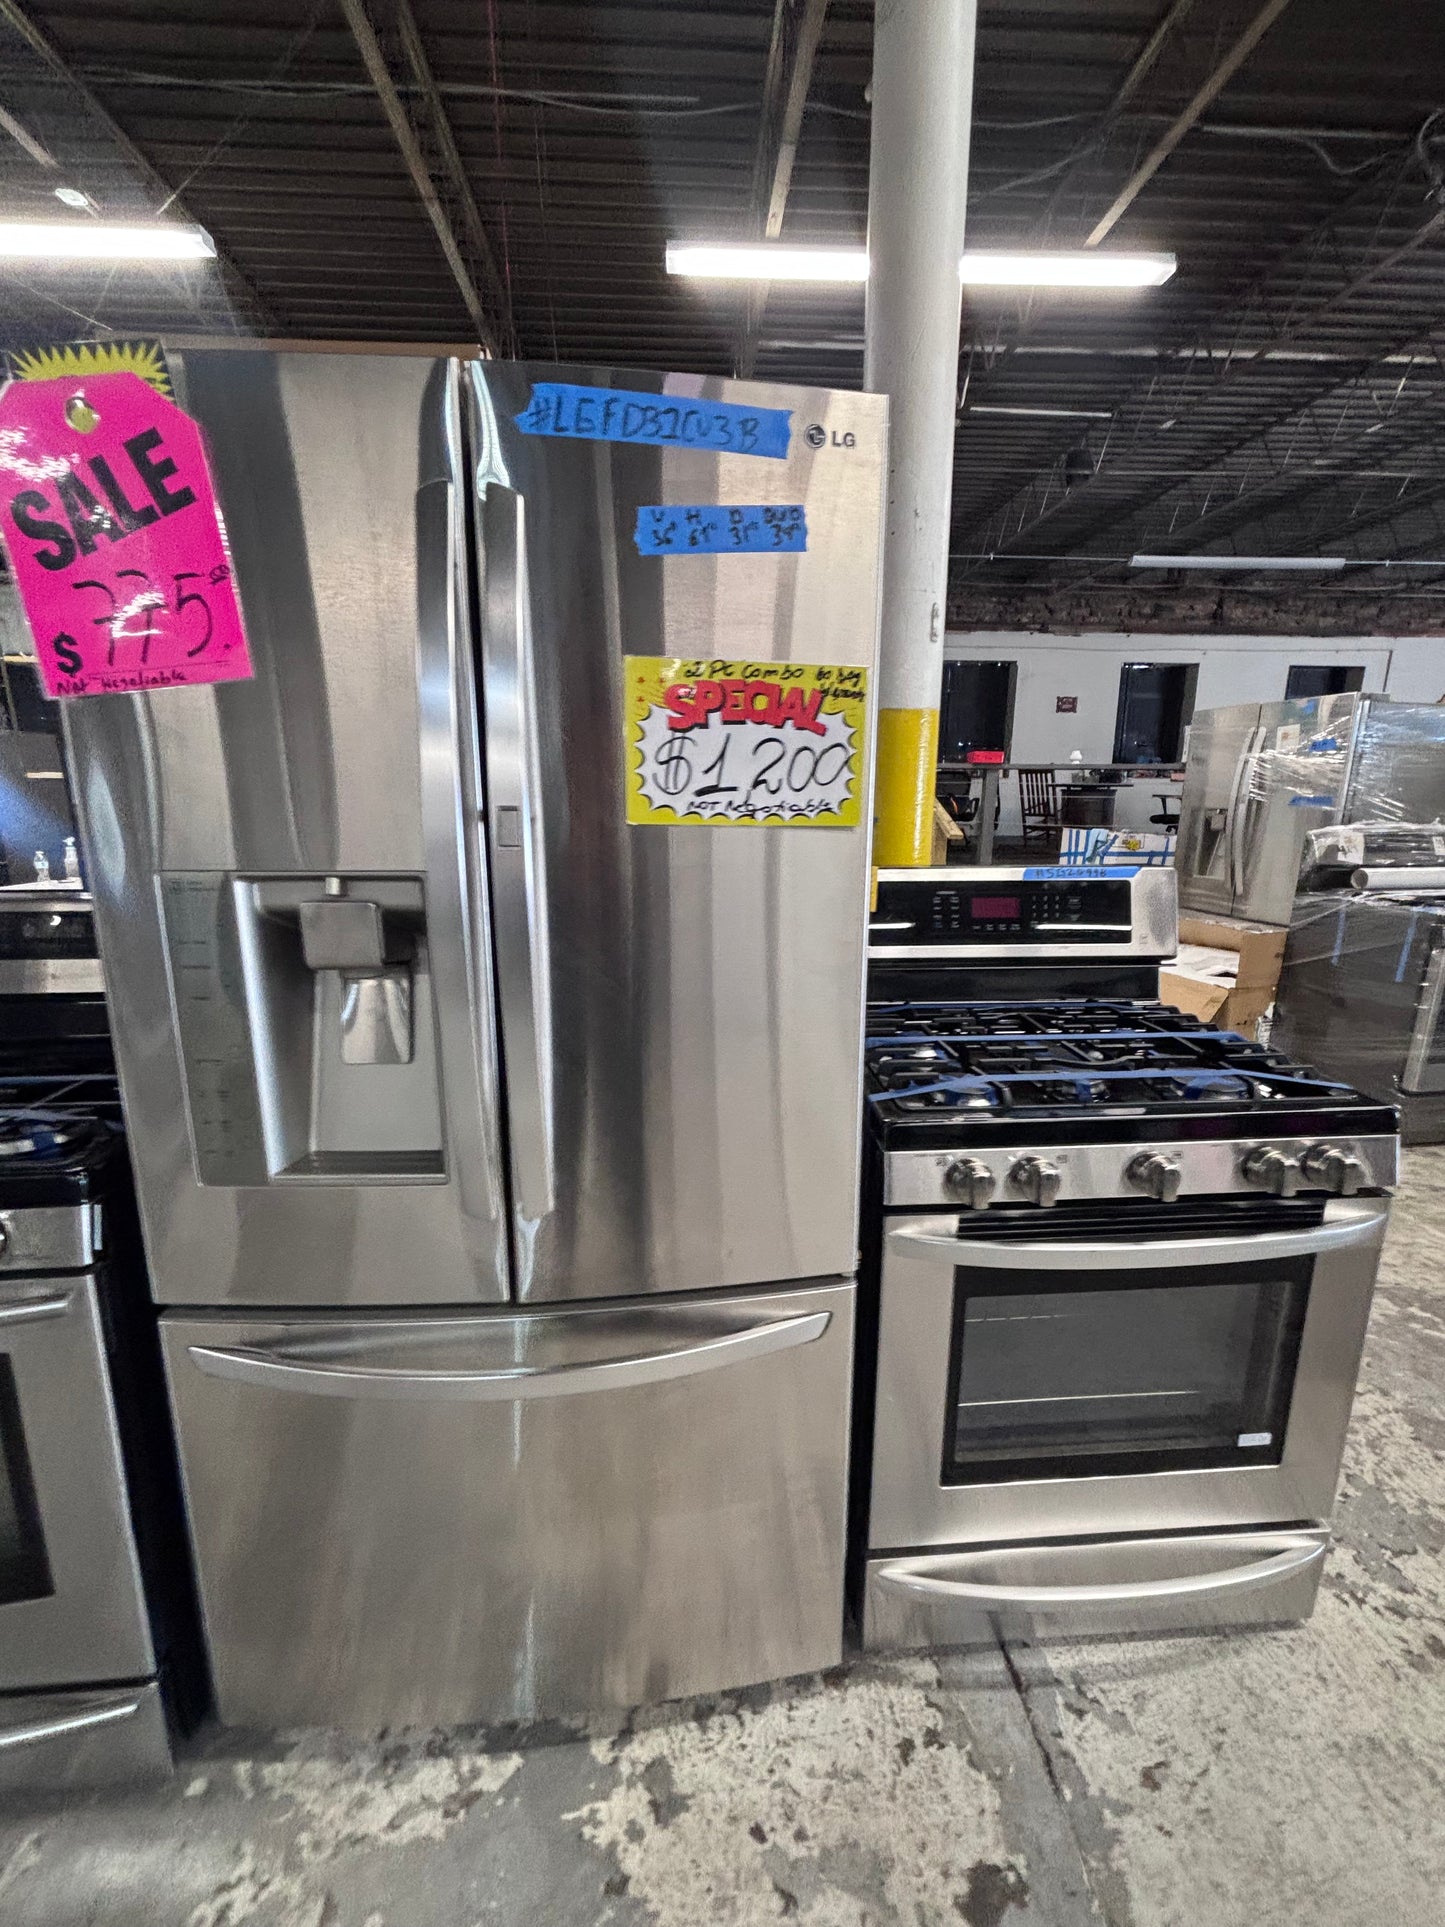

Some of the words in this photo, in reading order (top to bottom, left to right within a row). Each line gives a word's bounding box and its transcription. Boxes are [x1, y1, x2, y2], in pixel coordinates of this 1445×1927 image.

[832, 430, 857, 449] LG
[9, 427, 197, 571] SALE
[741, 665, 804, 681] Combo
[664, 679, 828, 737] SPECIAL
